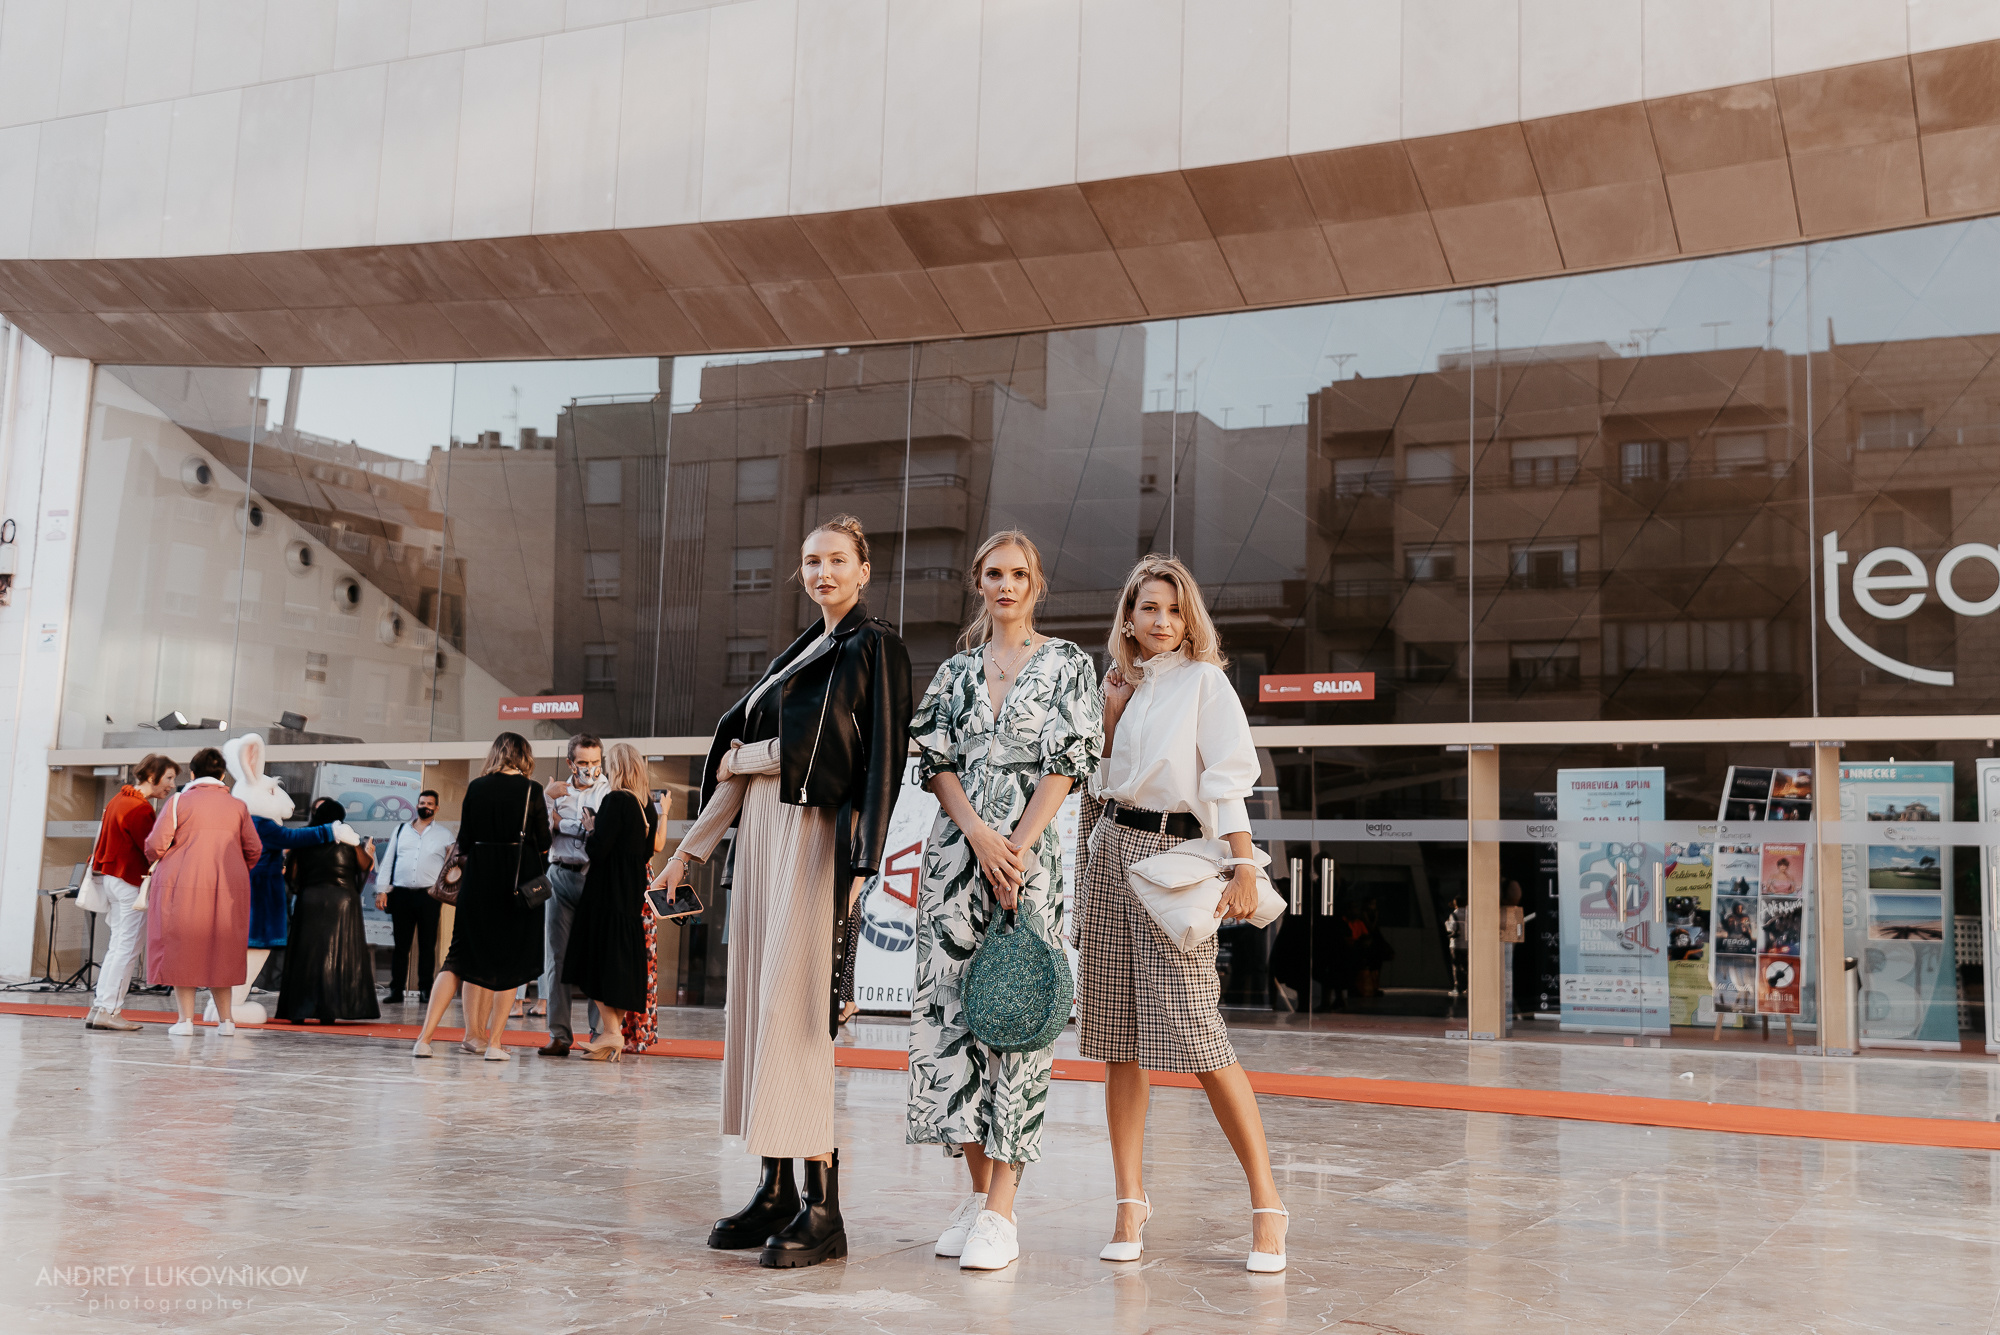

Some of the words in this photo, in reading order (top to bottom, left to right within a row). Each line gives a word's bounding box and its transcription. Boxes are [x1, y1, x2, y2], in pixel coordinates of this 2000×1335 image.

[1313, 680, 1363, 694] SALIDA
[532, 701, 579, 713] ENTRADA
[1571, 781, 1619, 790] TORREVIEJA
[1366, 823, 1392, 836] teatro
[1527, 824, 1554, 837] teatro
[1580, 919, 1625, 930] RUSSIAN
[1580, 930, 1602, 940] FILM
[1580, 941, 1622, 952] FESTIVAL
